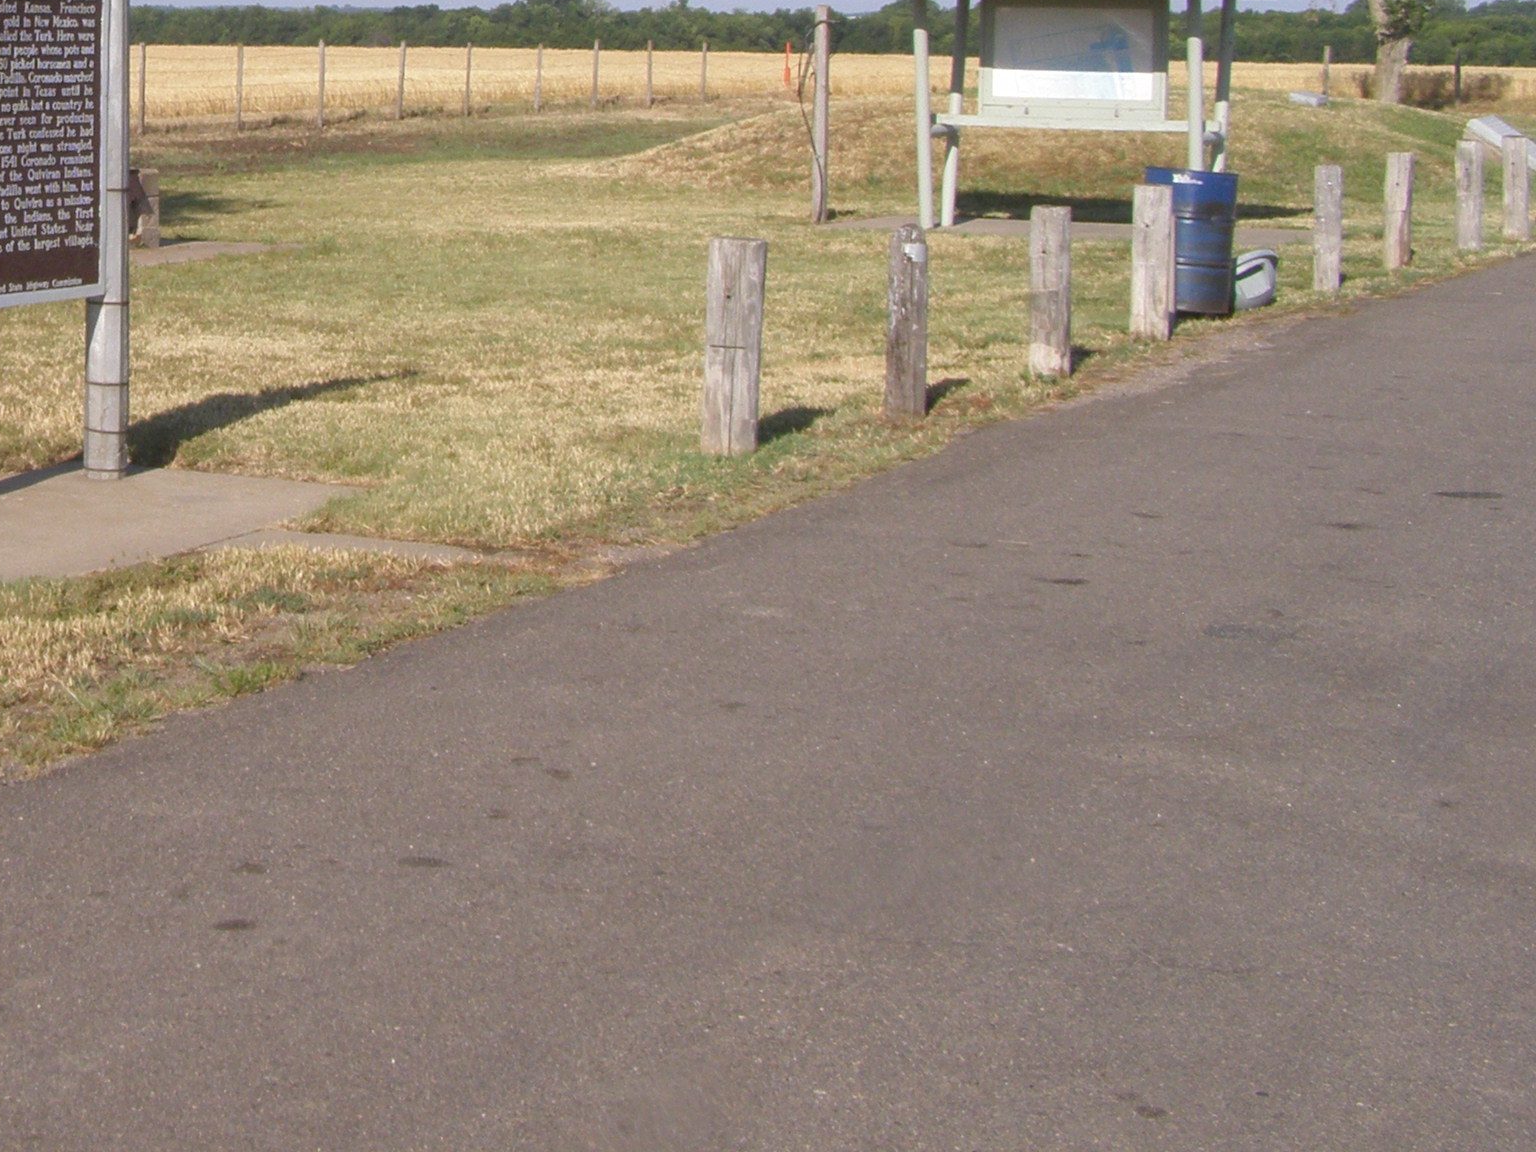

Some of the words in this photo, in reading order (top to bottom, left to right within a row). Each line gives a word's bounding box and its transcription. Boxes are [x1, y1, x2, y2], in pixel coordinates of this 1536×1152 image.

[60, 2, 95, 14] Francisco
[3, 15, 20, 29] gold
[34, 15, 49, 27] New
[20, 30, 32, 41] the
[57, 30, 74, 41] Here
[78, 32, 94, 41] were
[14, 44, 39, 58] people
[41, 45, 62, 55] whose
[28, 72, 62, 83] Coronado
[34, 85, 56, 97] Texas
[52, 99, 82, 111] country
[56, 113, 94, 127] producing
[7, 128, 26, 140] Turk
[21, 154, 56, 166] Coronado
[11, 224, 36, 237] United
